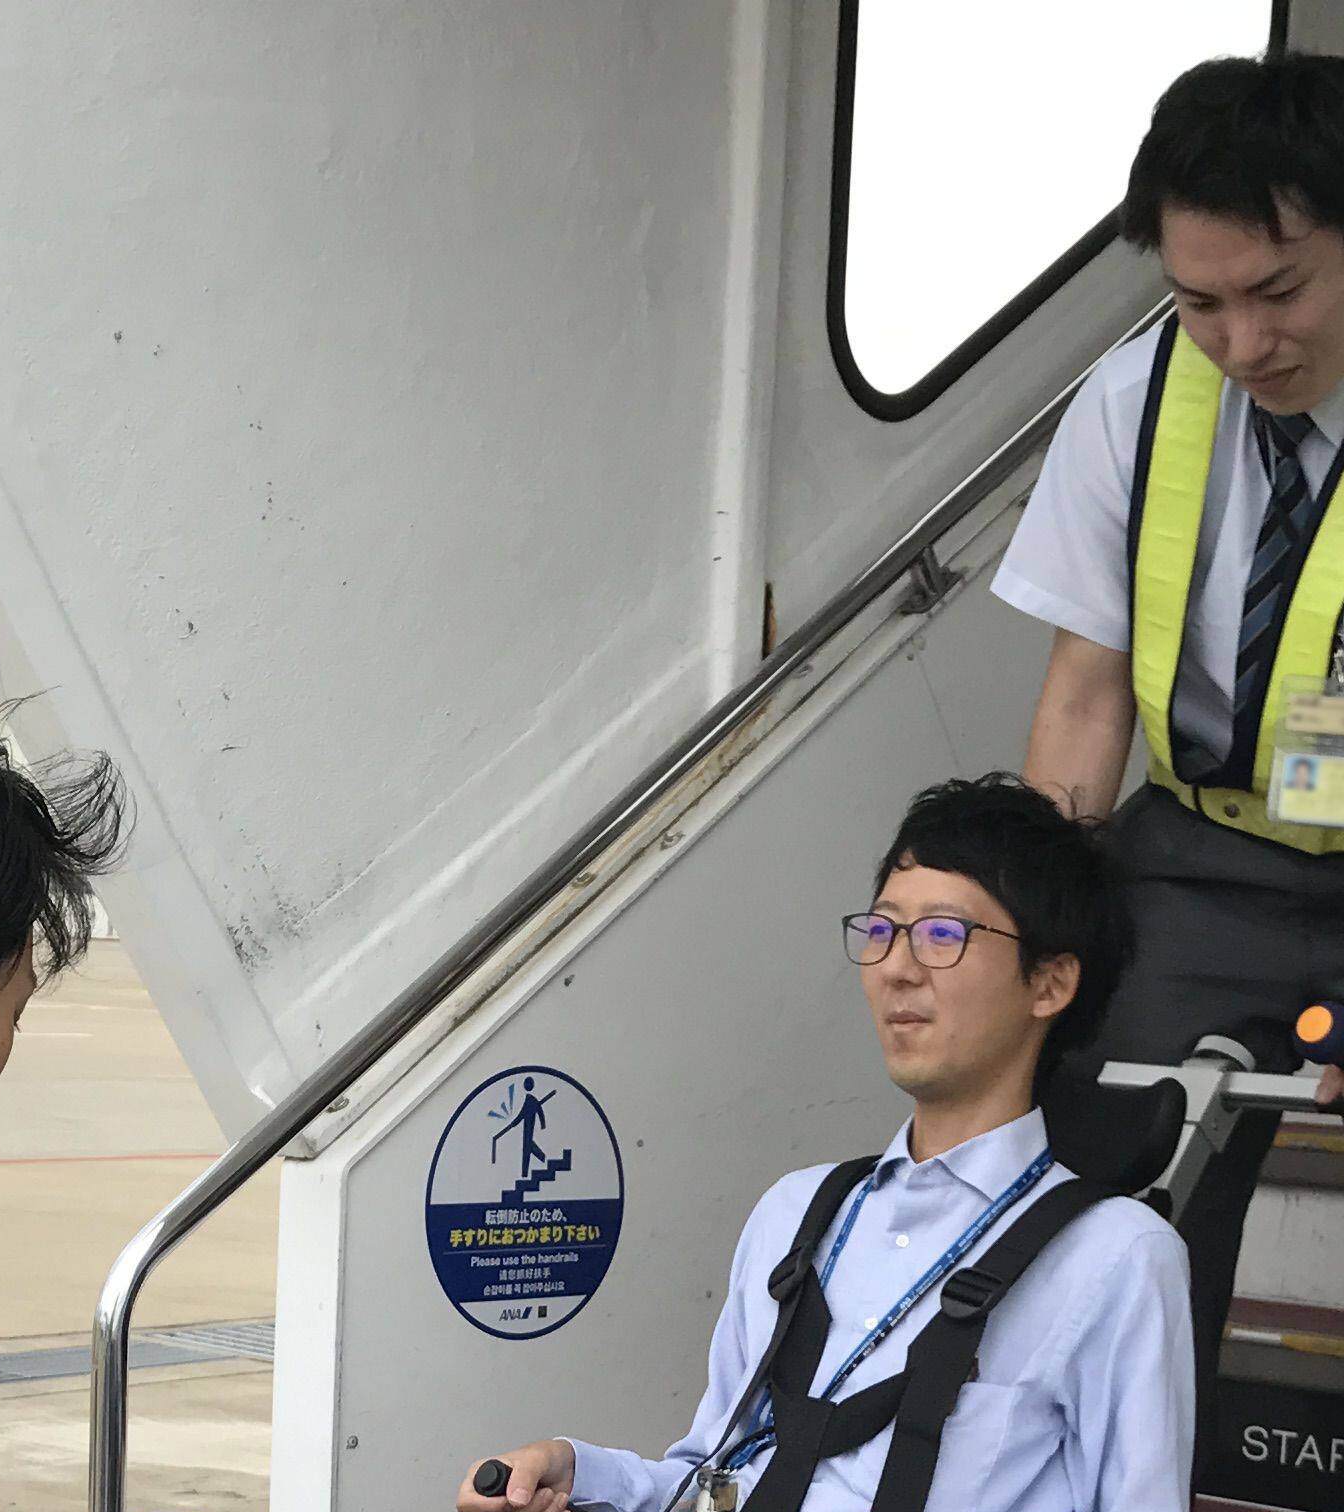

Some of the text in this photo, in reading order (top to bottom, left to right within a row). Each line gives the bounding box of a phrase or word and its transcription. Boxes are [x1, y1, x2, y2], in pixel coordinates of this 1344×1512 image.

[450, 1225, 600, 1248] 手すりにおつかまり下さい
[470, 1251, 579, 1267] Please use the handrails
[499, 1308, 523, 1321] ANA
